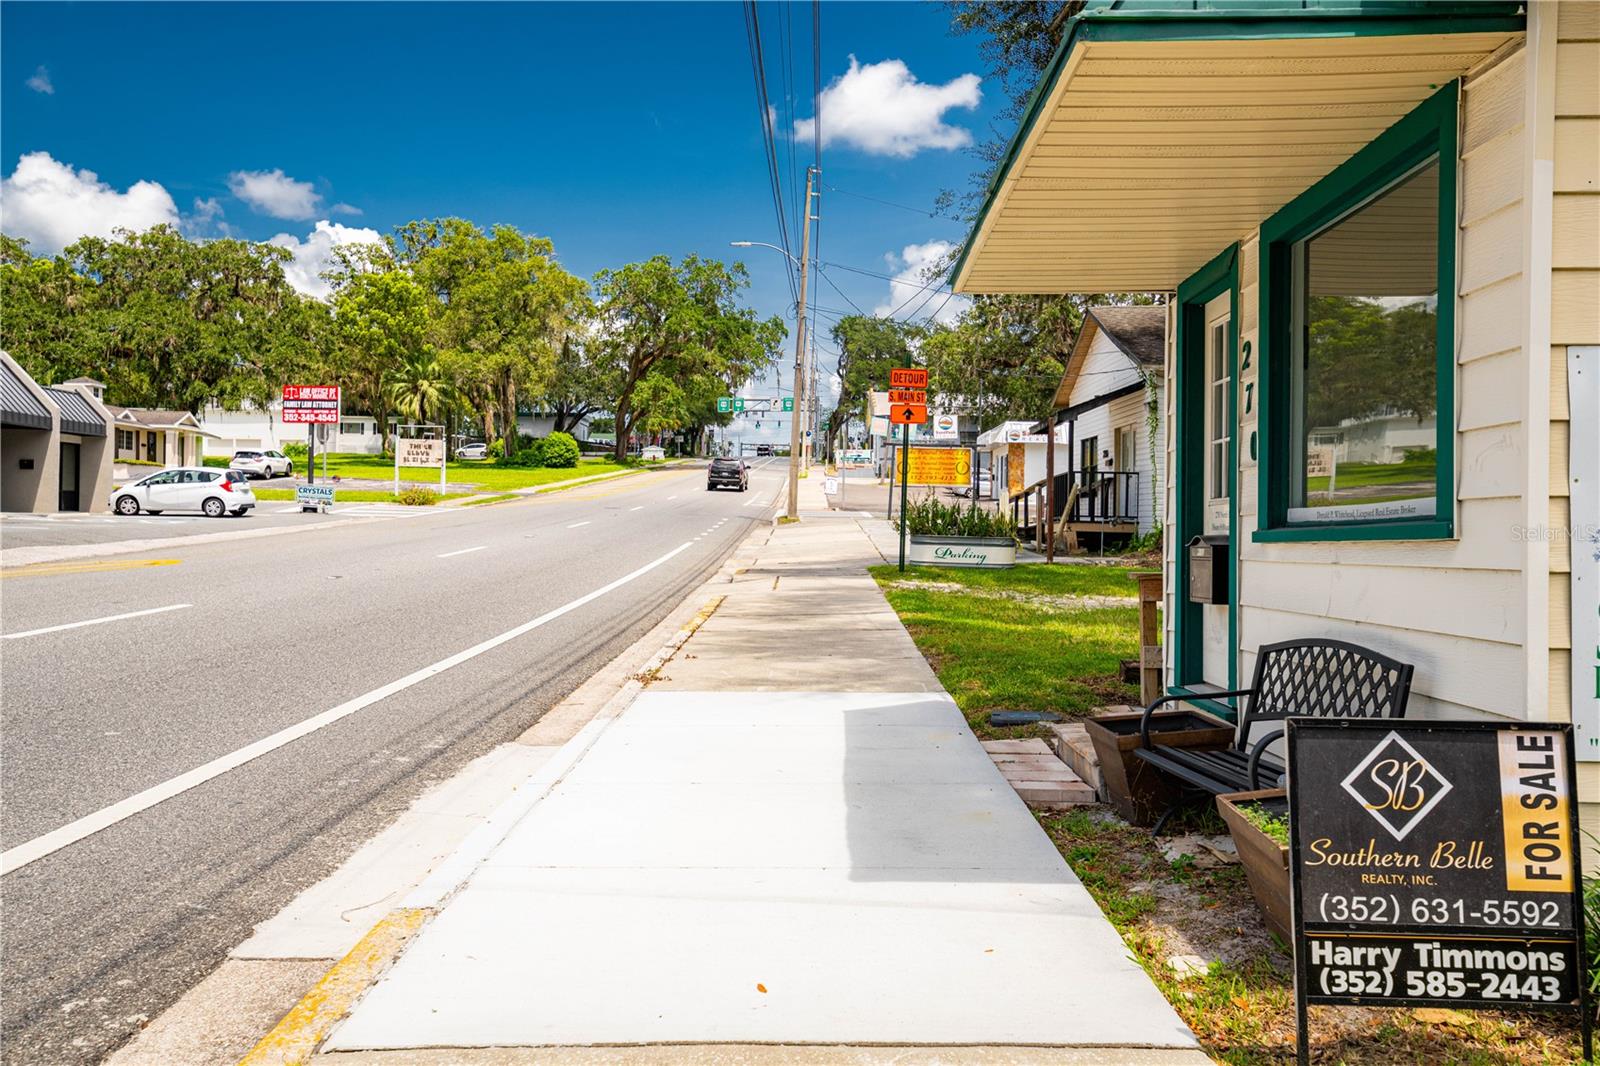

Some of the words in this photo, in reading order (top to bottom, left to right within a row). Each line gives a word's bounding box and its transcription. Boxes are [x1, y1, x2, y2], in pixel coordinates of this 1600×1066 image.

[893, 372, 925, 384] DETOUR
[283, 400, 301, 408] FAMILY
[301, 400, 313, 408] LAW
[312, 400, 337, 408] ATTORNEY
[889, 391, 895, 402] S.
[898, 392, 915, 402] MAIN
[916, 392, 925, 402] ST
[298, 487, 333, 496] CRYSTALS
[1400, 505, 1416, 514] Broker
[934, 546, 987, 566] Parking
[1365, 758, 1426, 811] SB
[1516, 735, 1559, 811] SALE
[1304, 838, 1421, 868] Southern
[1430, 840, 1494, 870] Belle
[1522, 821, 1563, 881] FOR
[1361, 873, 1407, 886] REALTY,
[1412, 875, 1438, 886] INC.
[1319, 892, 1400, 924] (352)
[1411, 897, 1560, 927] 631-5592
[1310, 940, 1402, 972] Harry
[1413, 942, 1566, 972] Timmons
[1319, 967, 1395, 997] (352)
[1406, 970, 1561, 1002] 585-2443
